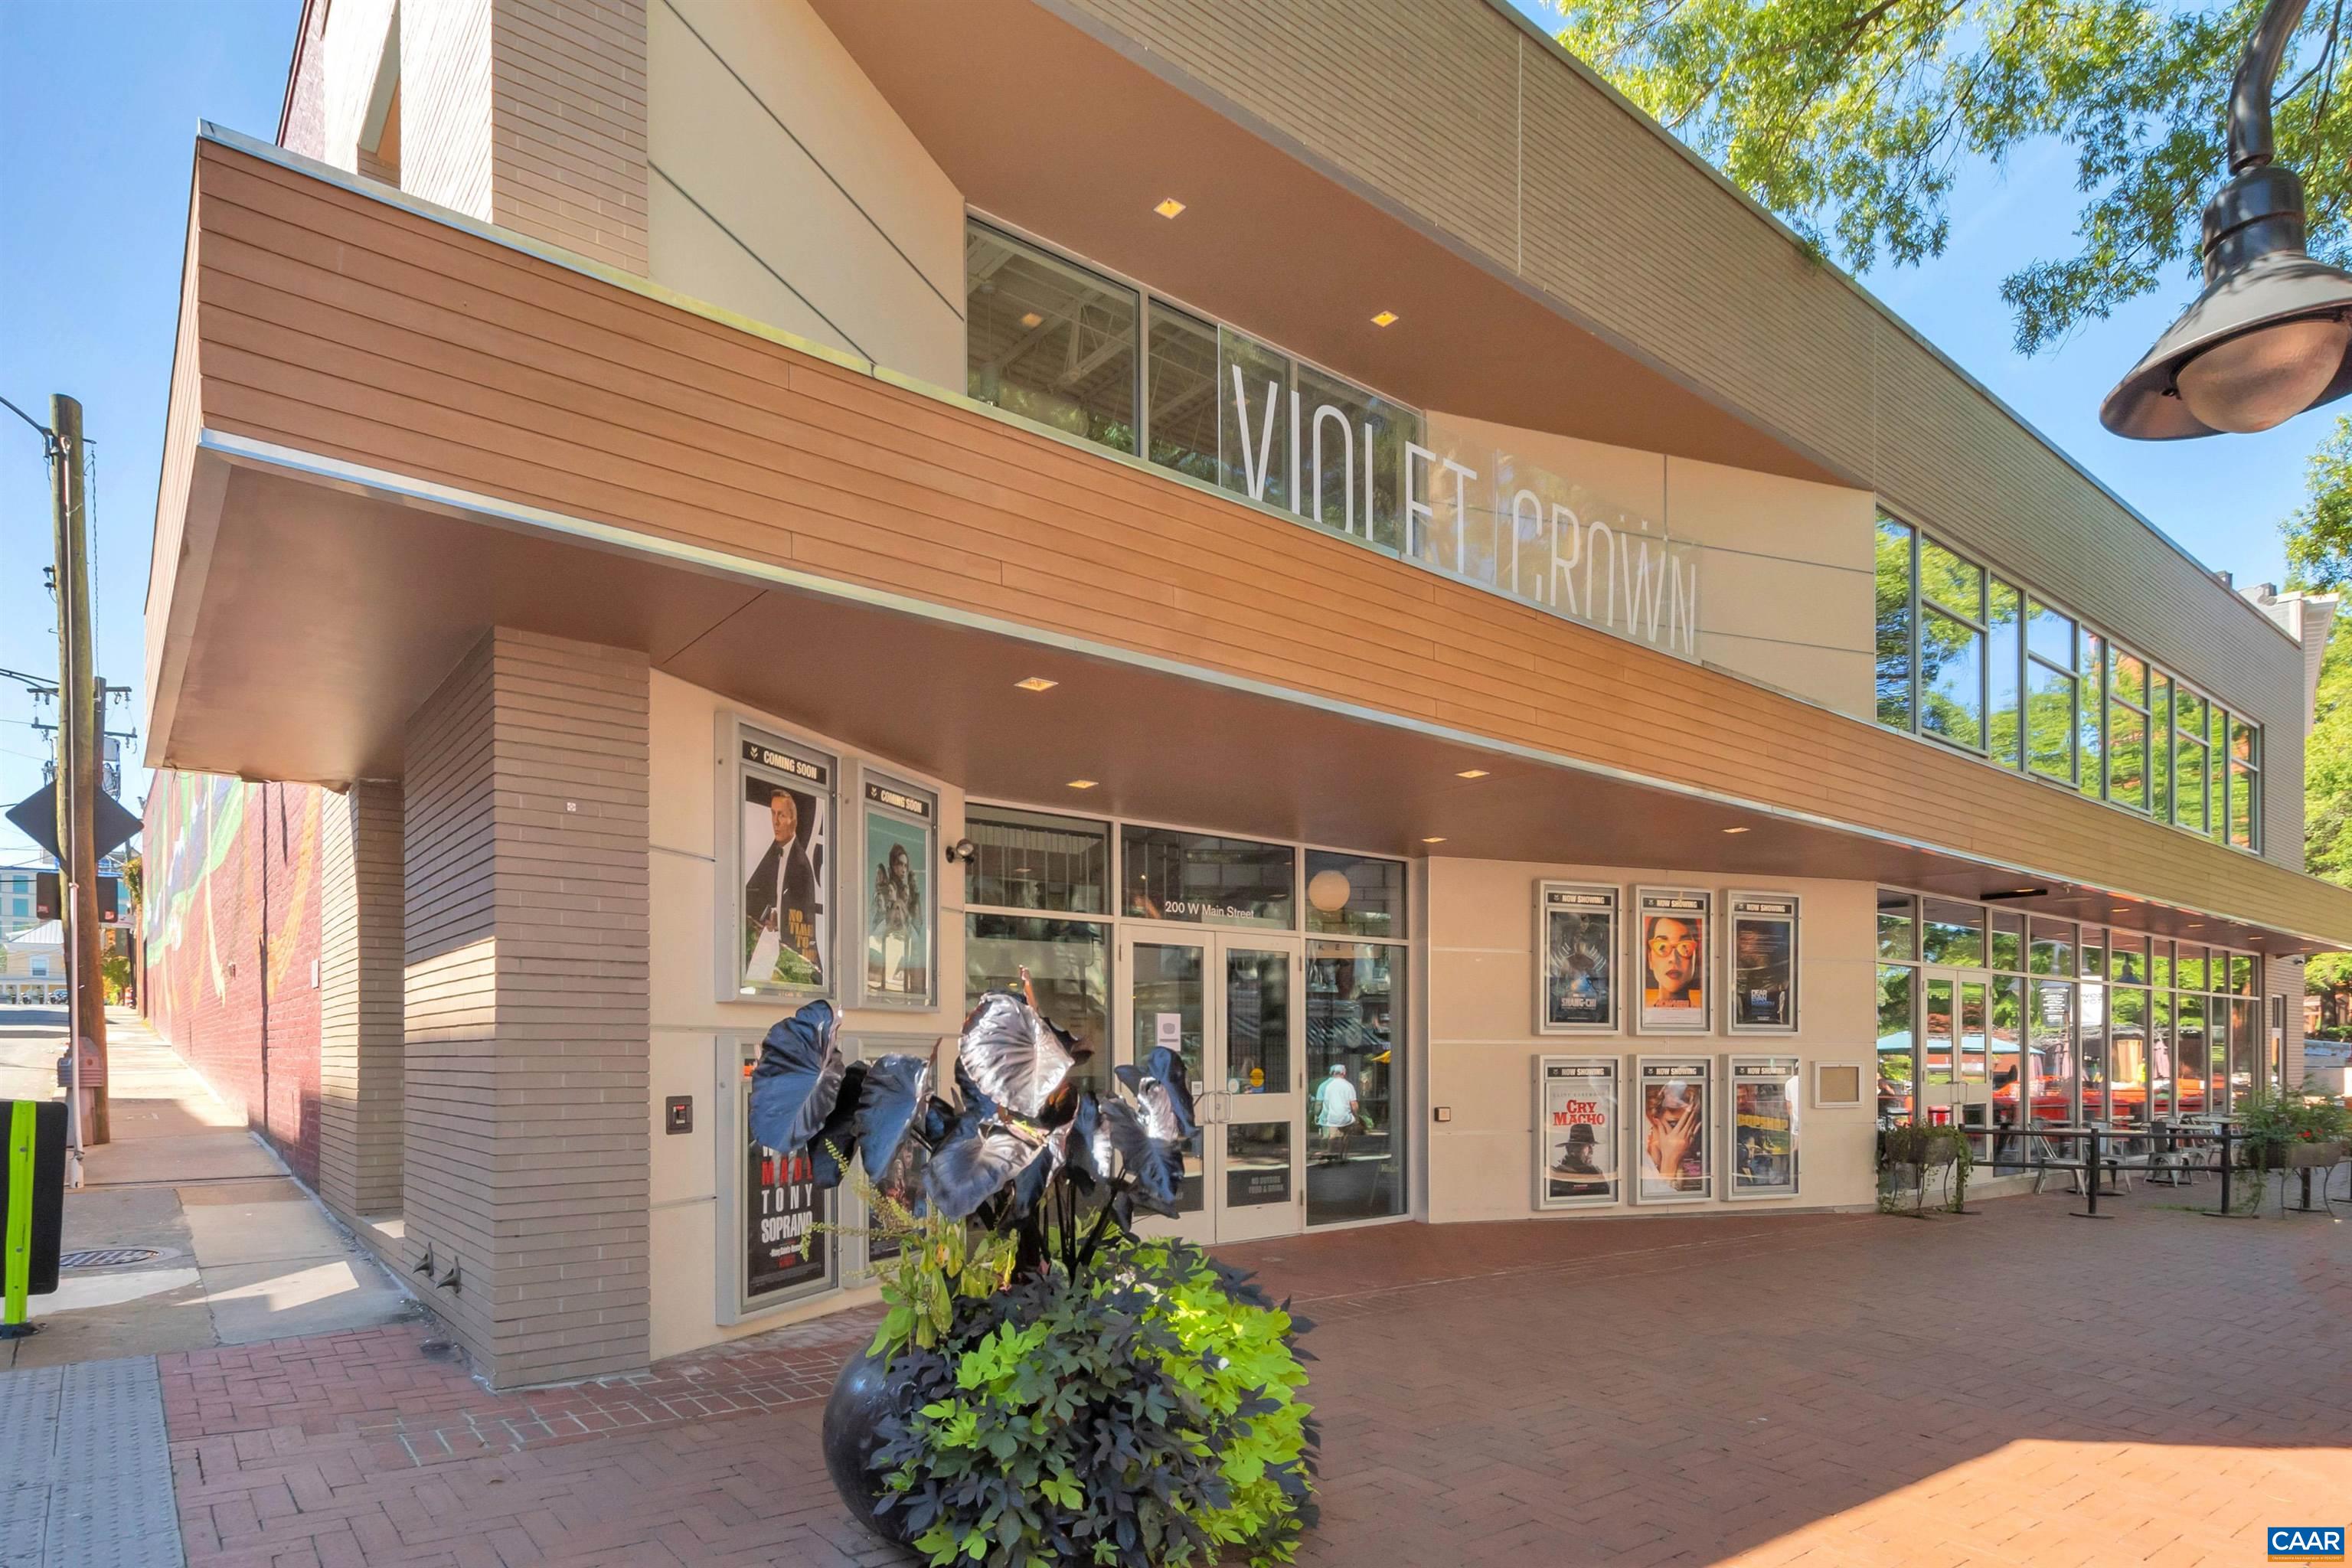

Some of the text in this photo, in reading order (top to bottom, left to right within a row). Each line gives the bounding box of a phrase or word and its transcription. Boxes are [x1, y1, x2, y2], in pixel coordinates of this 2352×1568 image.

[1232, 364, 1696, 656] VIOLET CROWN
[763, 750, 817, 779] COMING SOON
[880, 790, 922, 813] COMING SOON
[1562, 894, 1605, 904] NOW SHOWING
[1671, 900, 1697, 909] SHOWING
[1165, 901, 1254, 919] 200 W Main Street
[1760, 904, 1785, 913] SHOWING
[789, 909, 802, 923] NO
[1577, 1067, 1605, 1076] SHOWING
[1566, 1099, 1597, 1113] CRY
[1553, 1112, 1605, 1125] MACHO
[761, 1183, 812, 1214] TONY
[761, 1210, 813, 1243] SOPRANO
